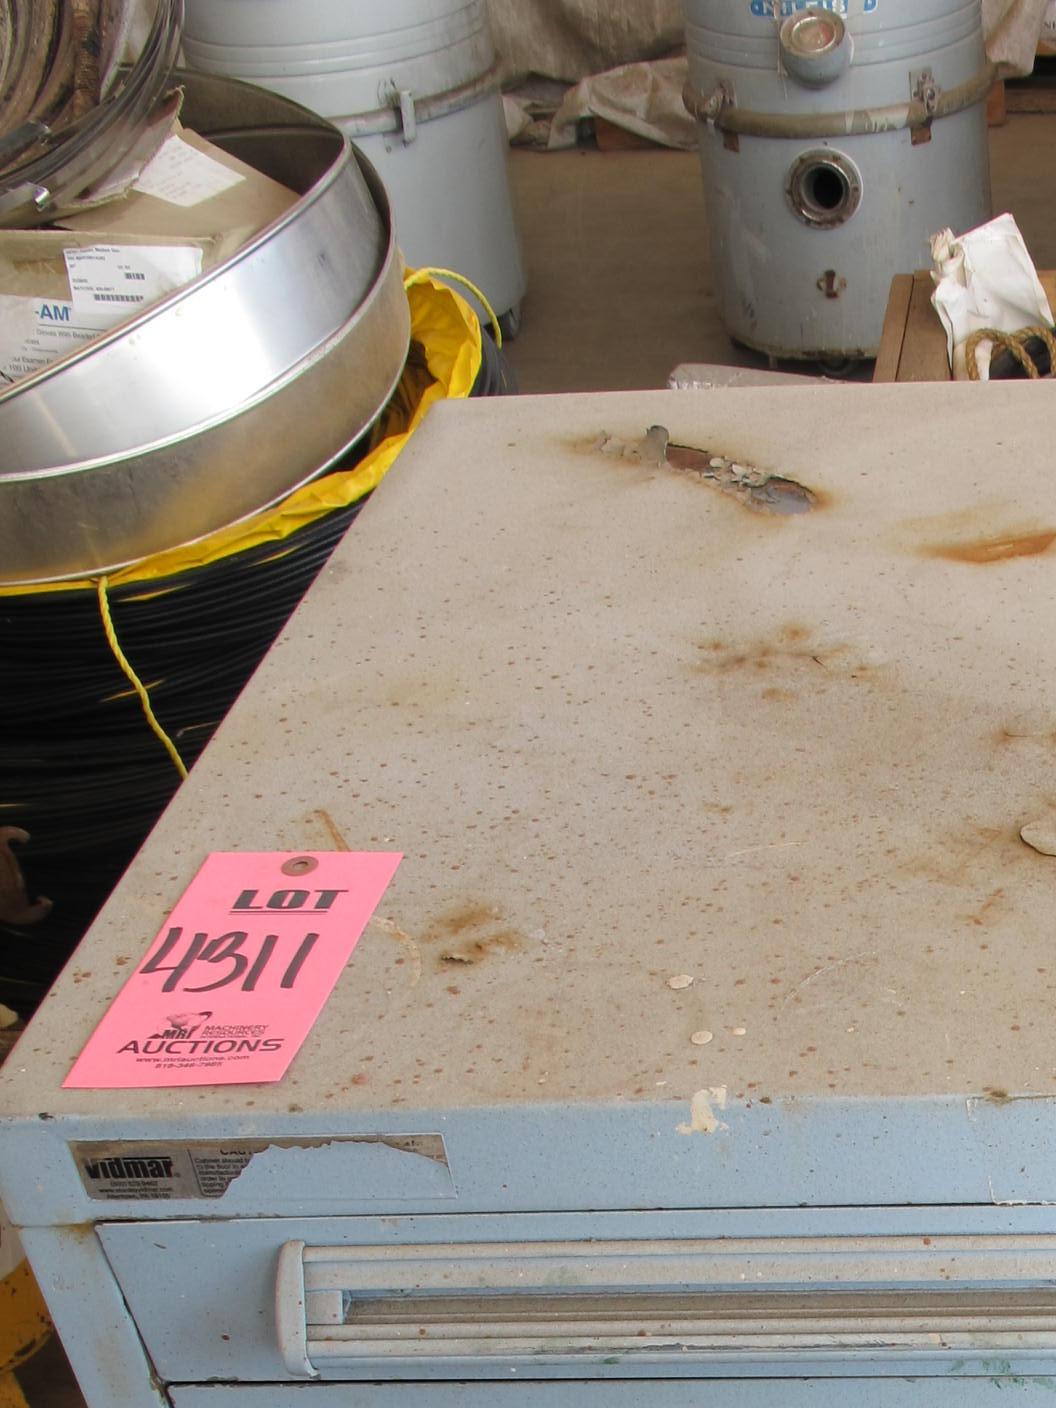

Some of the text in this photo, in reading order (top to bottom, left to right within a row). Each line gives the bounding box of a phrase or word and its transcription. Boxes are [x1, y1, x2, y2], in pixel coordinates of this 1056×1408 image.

[231, 889, 349, 910] LOT
[139, 926, 320, 993] 4311
[161, 1027, 199, 1040] MRI
[116, 1038, 285, 1054] AUCTIONS
[84, 1156, 174, 1179] vidmar
